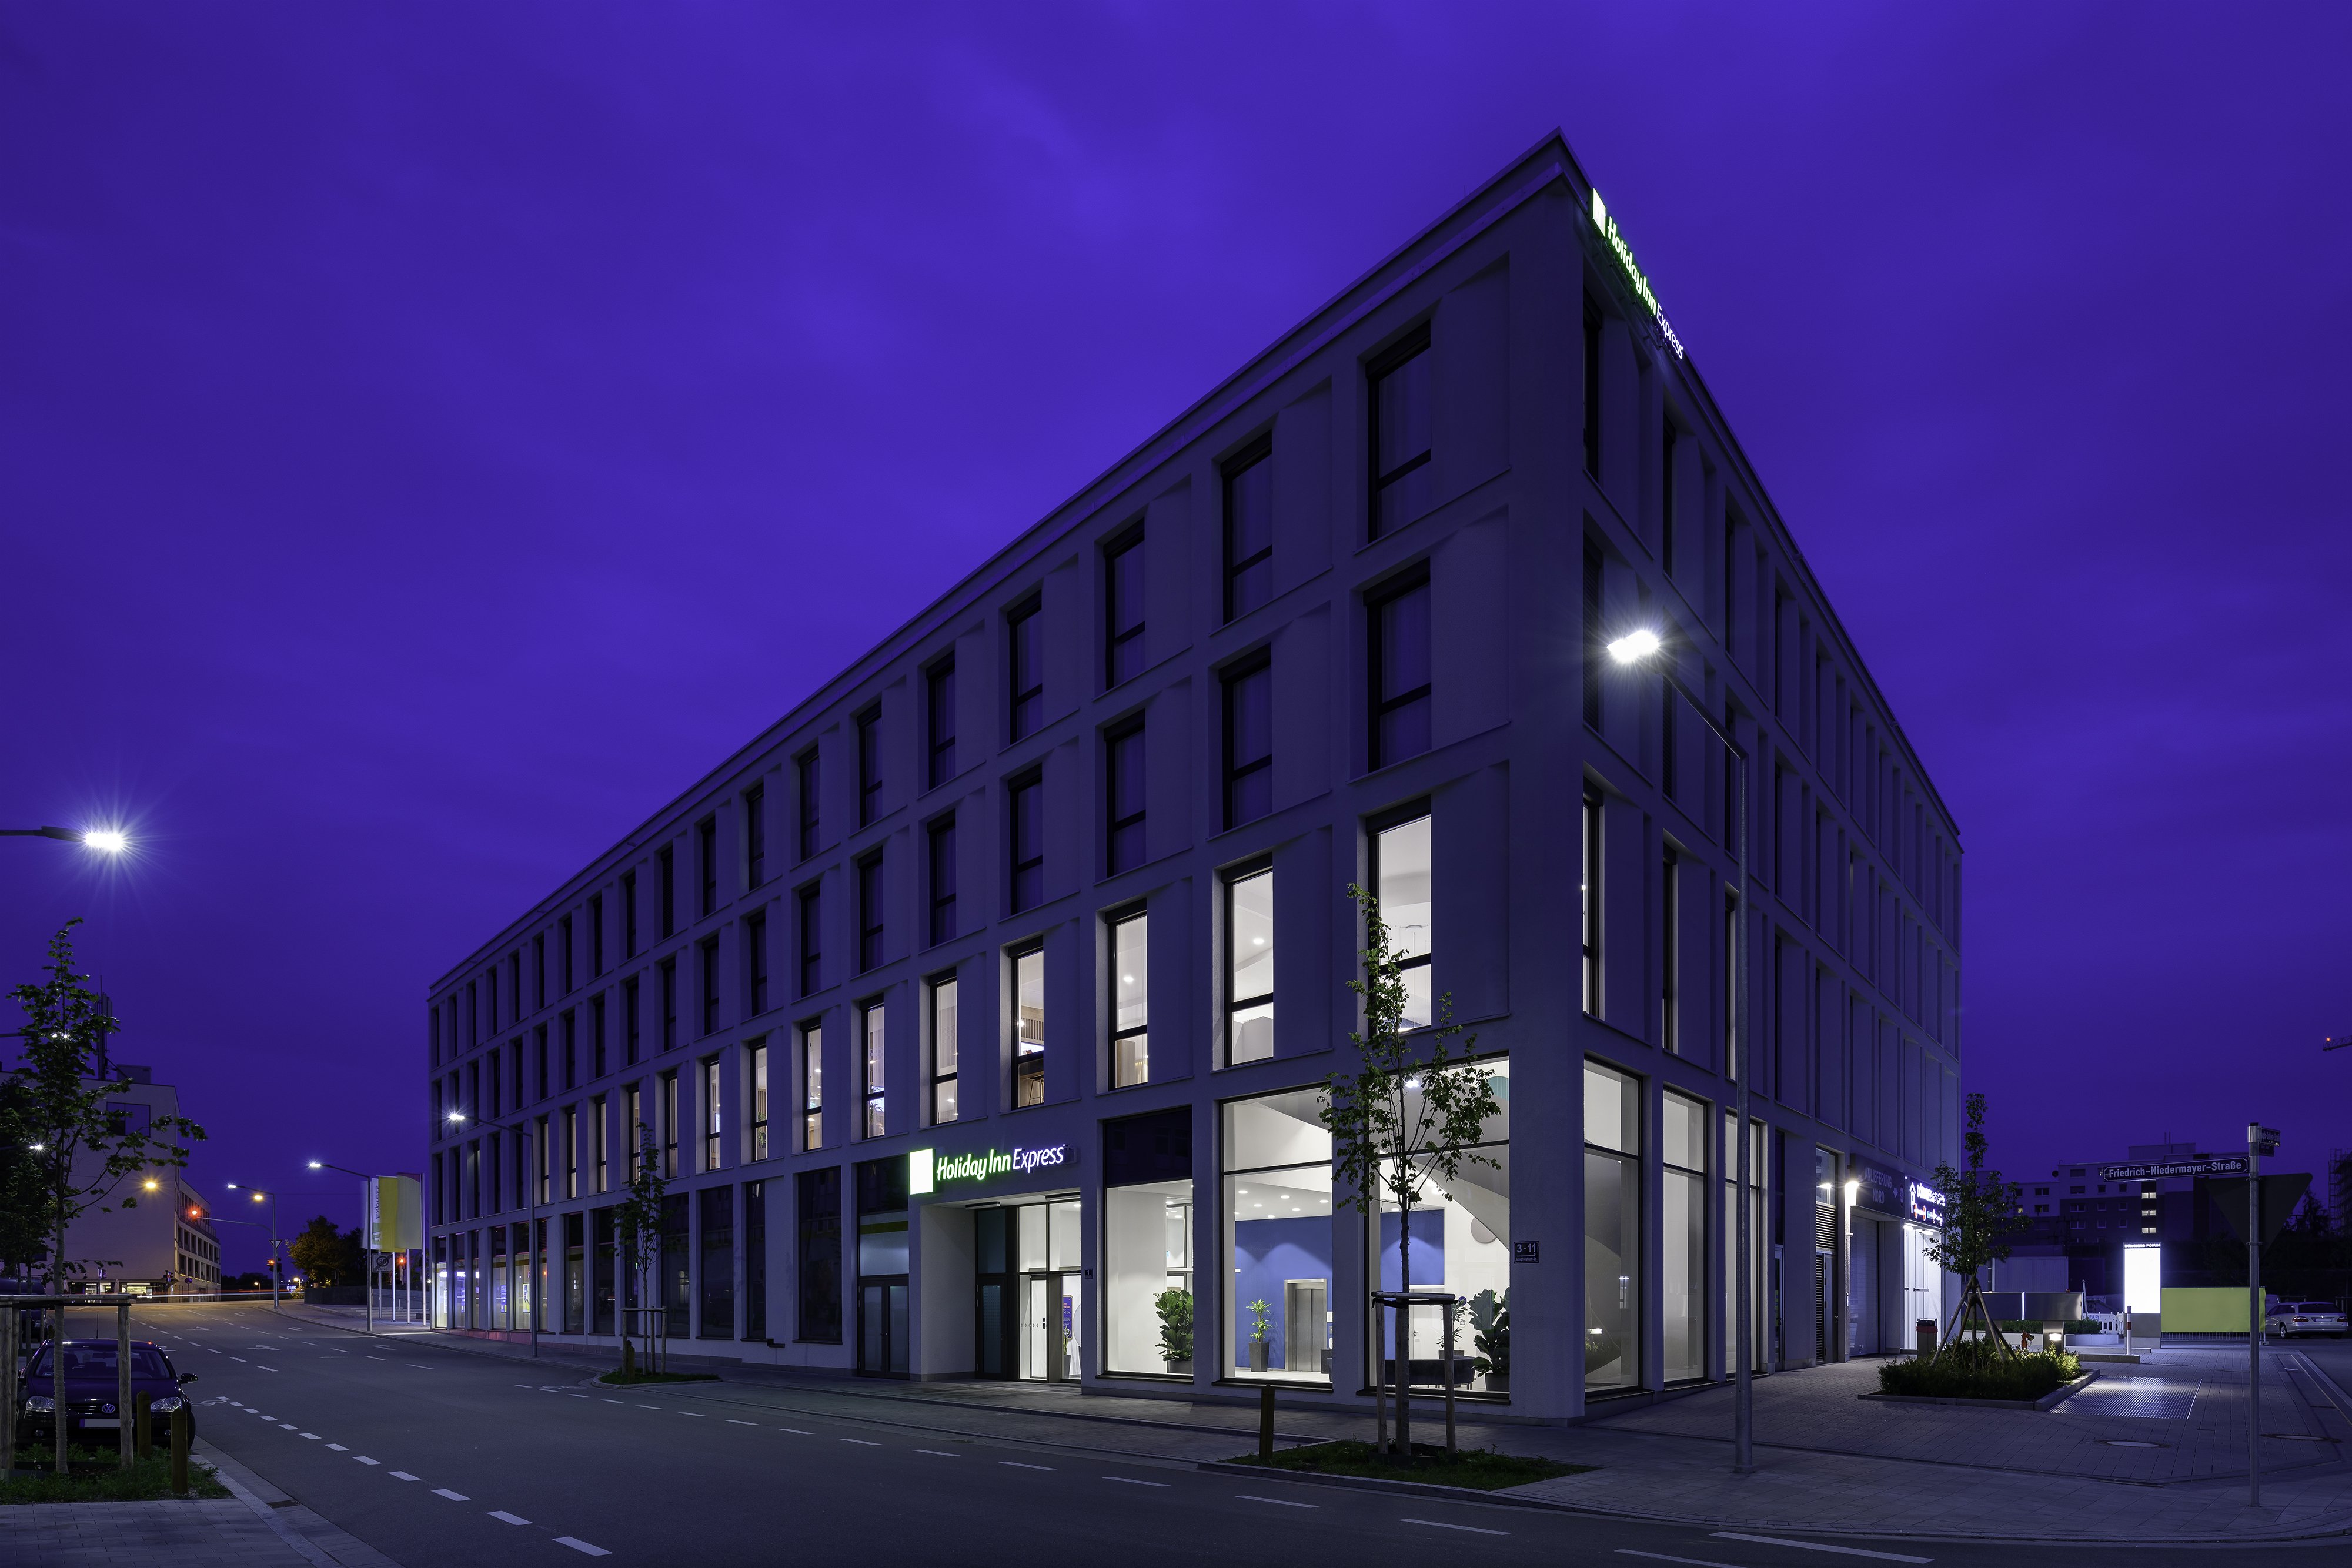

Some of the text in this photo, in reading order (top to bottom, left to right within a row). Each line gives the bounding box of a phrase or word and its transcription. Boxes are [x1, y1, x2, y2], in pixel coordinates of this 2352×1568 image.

[1607, 216, 1683, 360] Holiday Inn Express
[936, 1145, 1064, 1181] Holiday Inn Express
[2108, 1161, 2242, 1178] Friedrich-Niedermayer-Straße
[1865, 1166, 1892, 1189] ANLIEFERUNG
[1873, 1188, 1885, 1205] NORD
